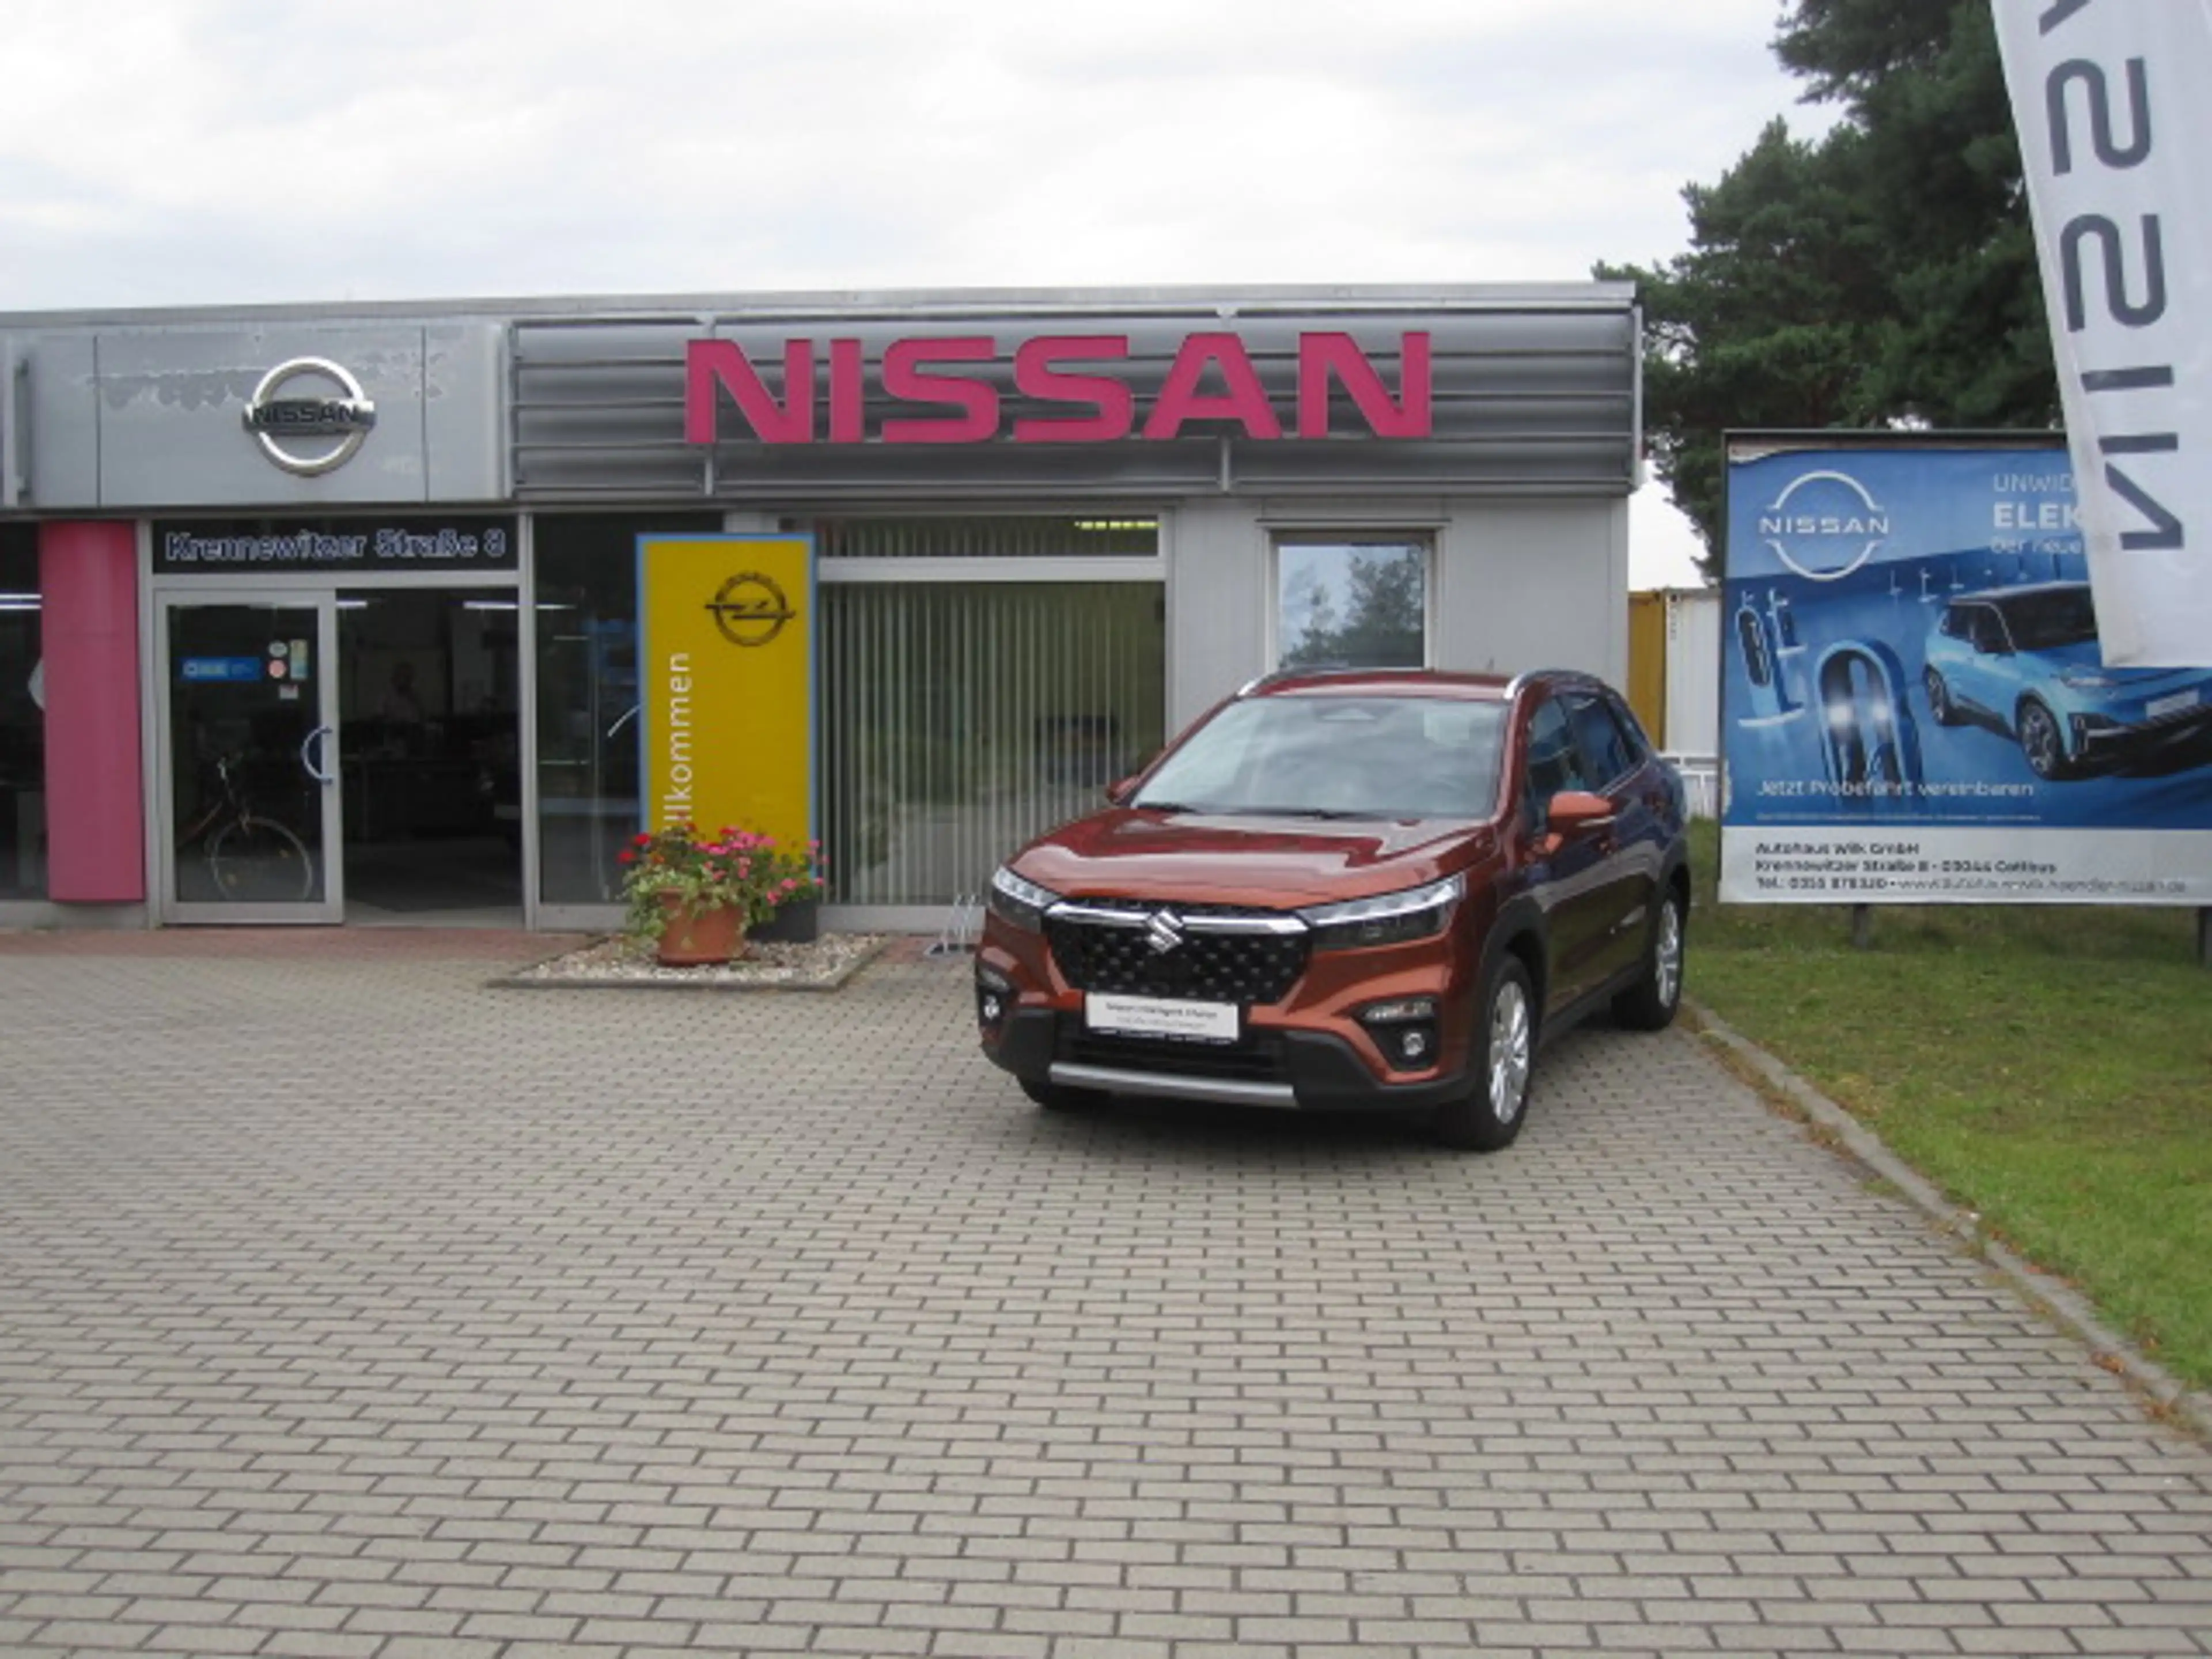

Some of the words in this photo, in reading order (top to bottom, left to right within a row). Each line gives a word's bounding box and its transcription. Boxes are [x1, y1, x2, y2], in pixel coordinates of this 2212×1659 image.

[684, 330, 1433, 445] NISSAN
[252, 402, 358, 425] NISSAN
[1759, 516, 1889, 534] NISSAN
[374, 528, 478, 558] Straße
[483, 528, 506, 558] 8
[663, 652, 693, 834] llkommen
[1758, 779, 1805, 797] Jetzt
[1809, 778, 1912, 797] Probefahrt
[1917, 780, 2035, 797] vereinbaren
[1755, 842, 1830, 855] Autohaus
[1869, 842, 1920, 855] GmbH
